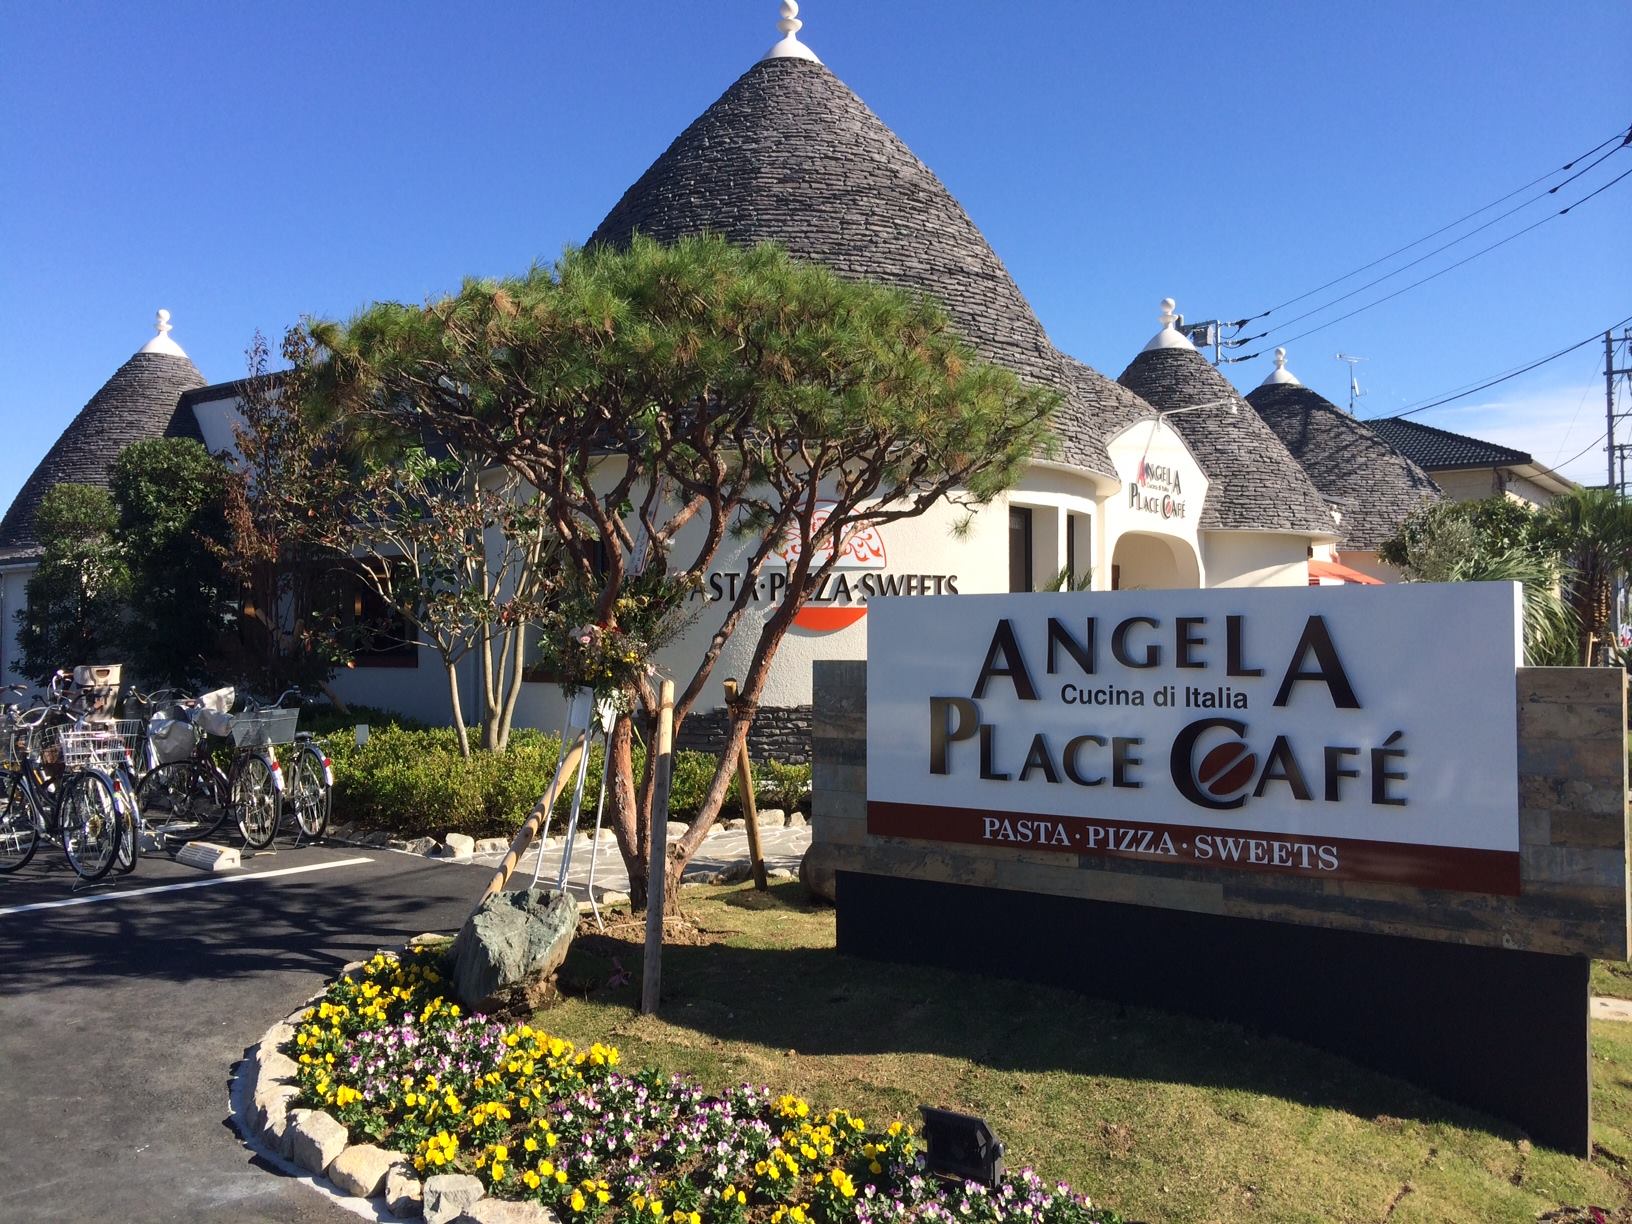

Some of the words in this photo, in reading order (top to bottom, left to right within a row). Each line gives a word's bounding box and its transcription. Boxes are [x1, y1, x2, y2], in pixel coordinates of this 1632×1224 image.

[1129, 482, 1159, 514] PLACE
[1136, 460, 1182, 495] ANGELA
[971, 615, 1361, 709] ANGELA
[1061, 683, 1145, 706] Cucina
[1153, 686, 1176, 707] di
[1185, 687, 1249, 710] Italia
[930, 696, 1145, 789] PLACE
[1170, 717, 1408, 810] CAFÉ
[982, 817, 1072, 846] PASTA
[1086, 825, 1178, 856] PIZZA
[1194, 834, 1340, 871] SWEETS
